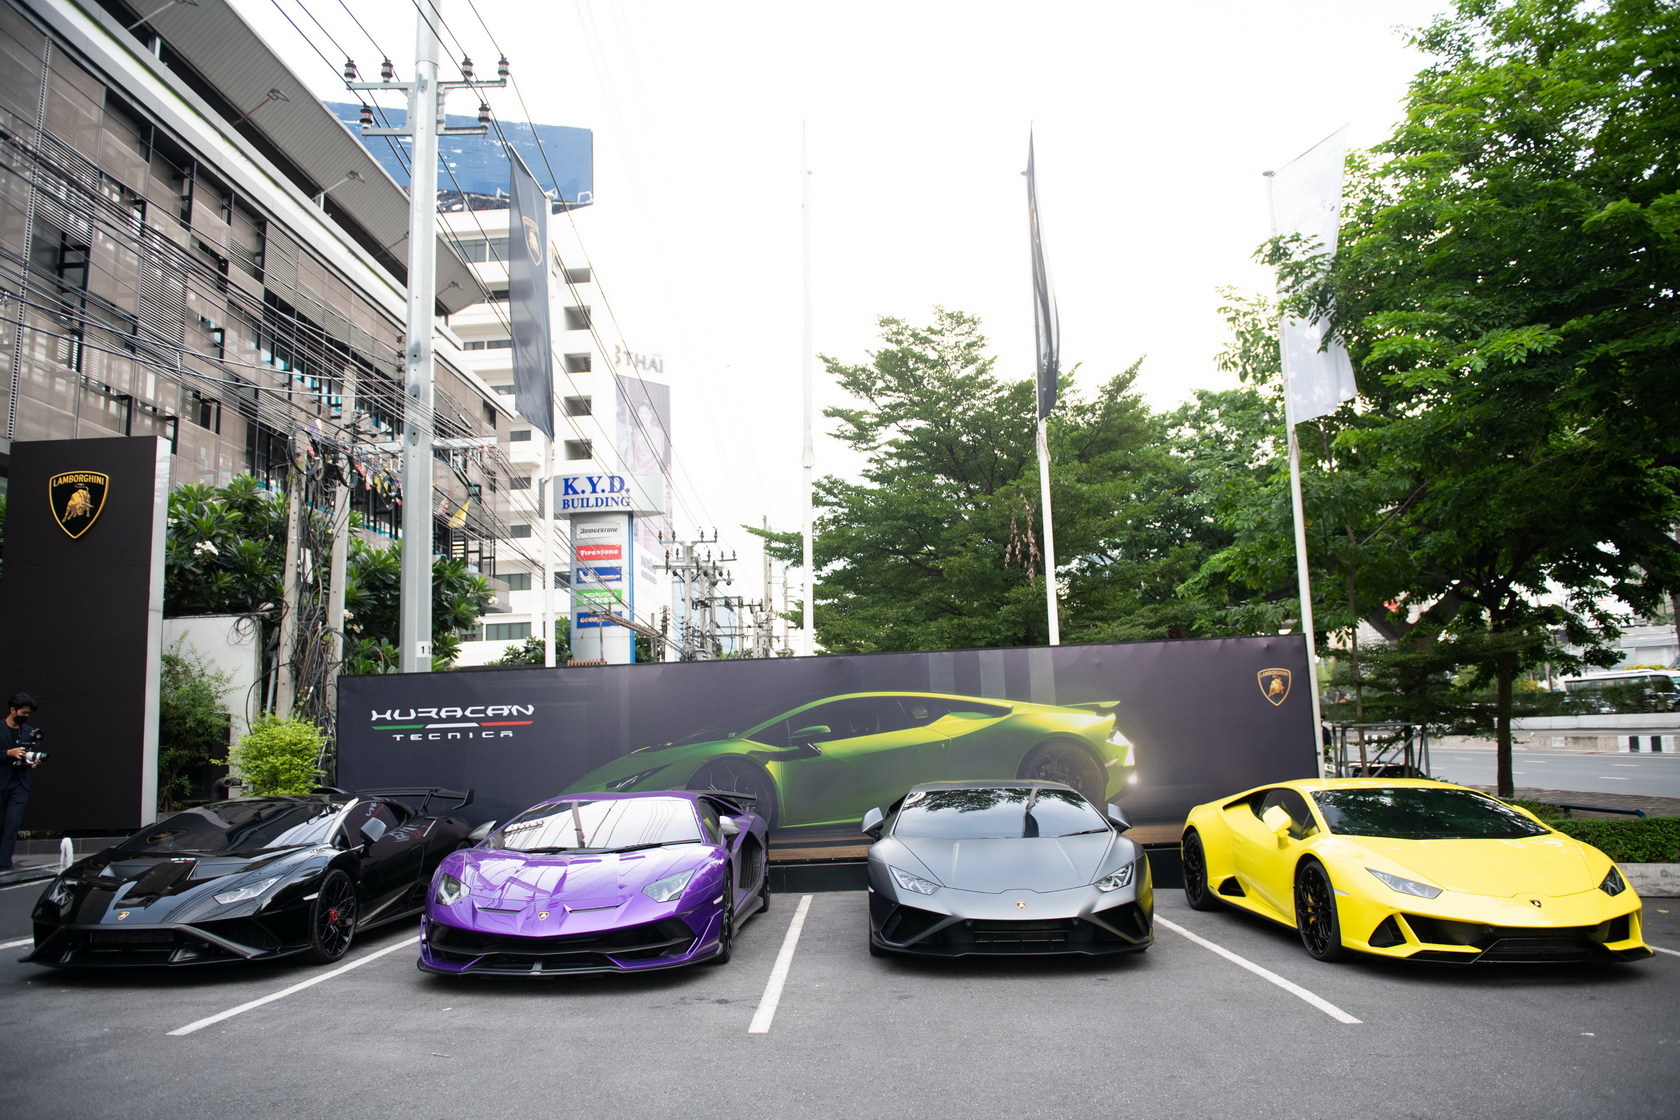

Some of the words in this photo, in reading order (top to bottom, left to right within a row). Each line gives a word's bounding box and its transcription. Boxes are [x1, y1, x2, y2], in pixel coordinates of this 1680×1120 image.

[53, 474, 105, 487] LAMBORGHINI
[562, 497, 631, 509] BUILDING
[392, 731, 513, 742] TECNICA
